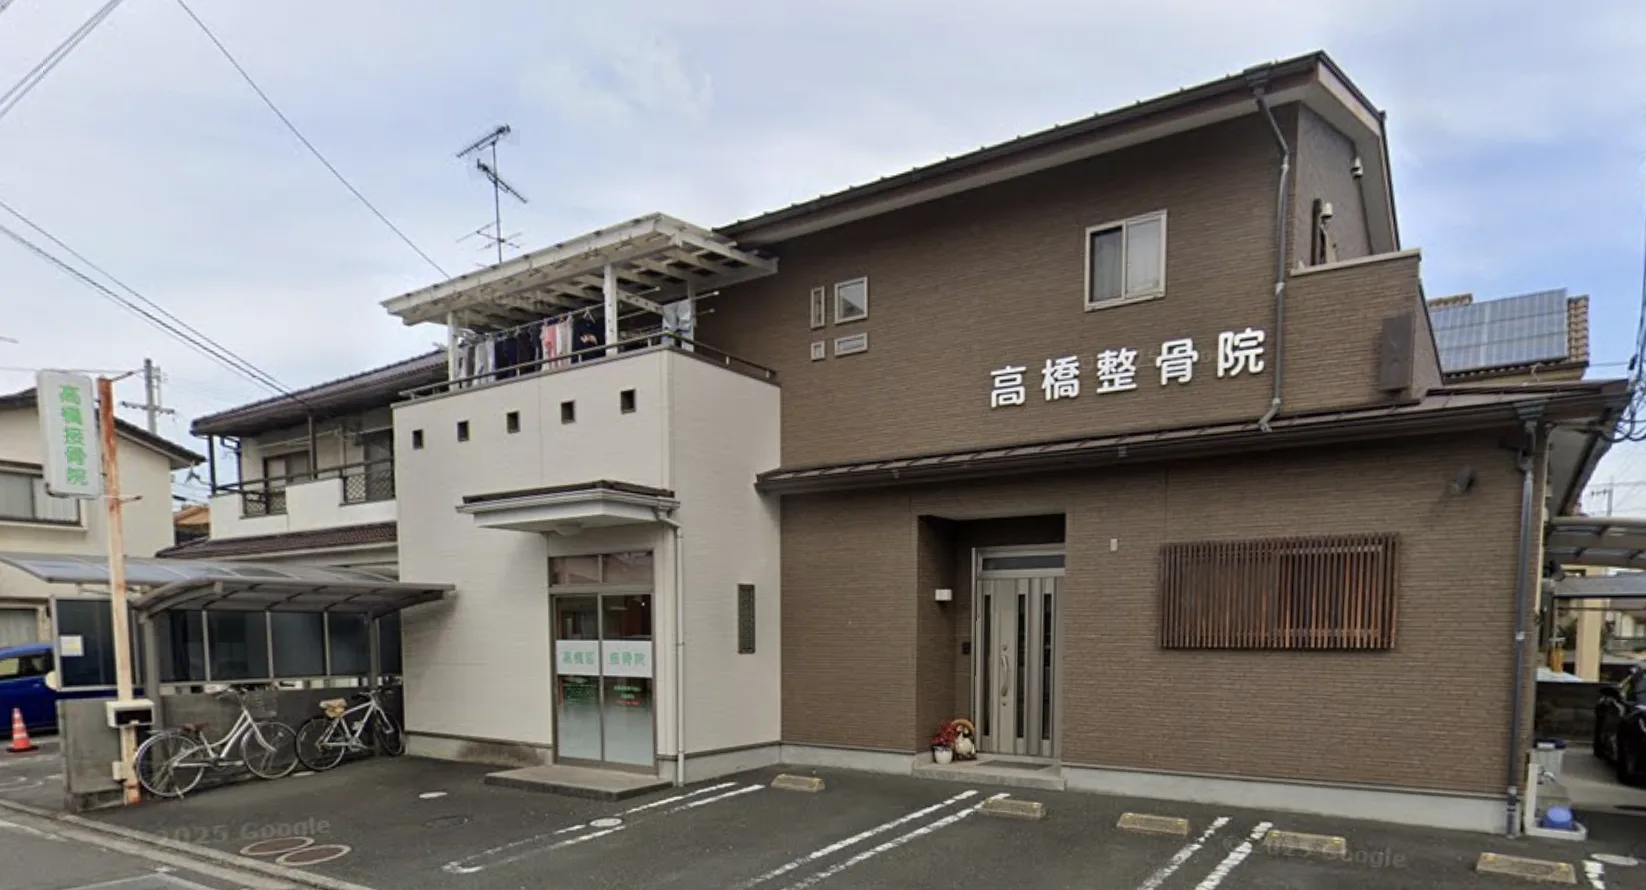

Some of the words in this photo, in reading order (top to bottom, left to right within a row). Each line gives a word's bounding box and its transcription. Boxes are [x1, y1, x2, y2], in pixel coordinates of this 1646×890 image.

[990, 327, 1266, 408] 高橋整骨院
